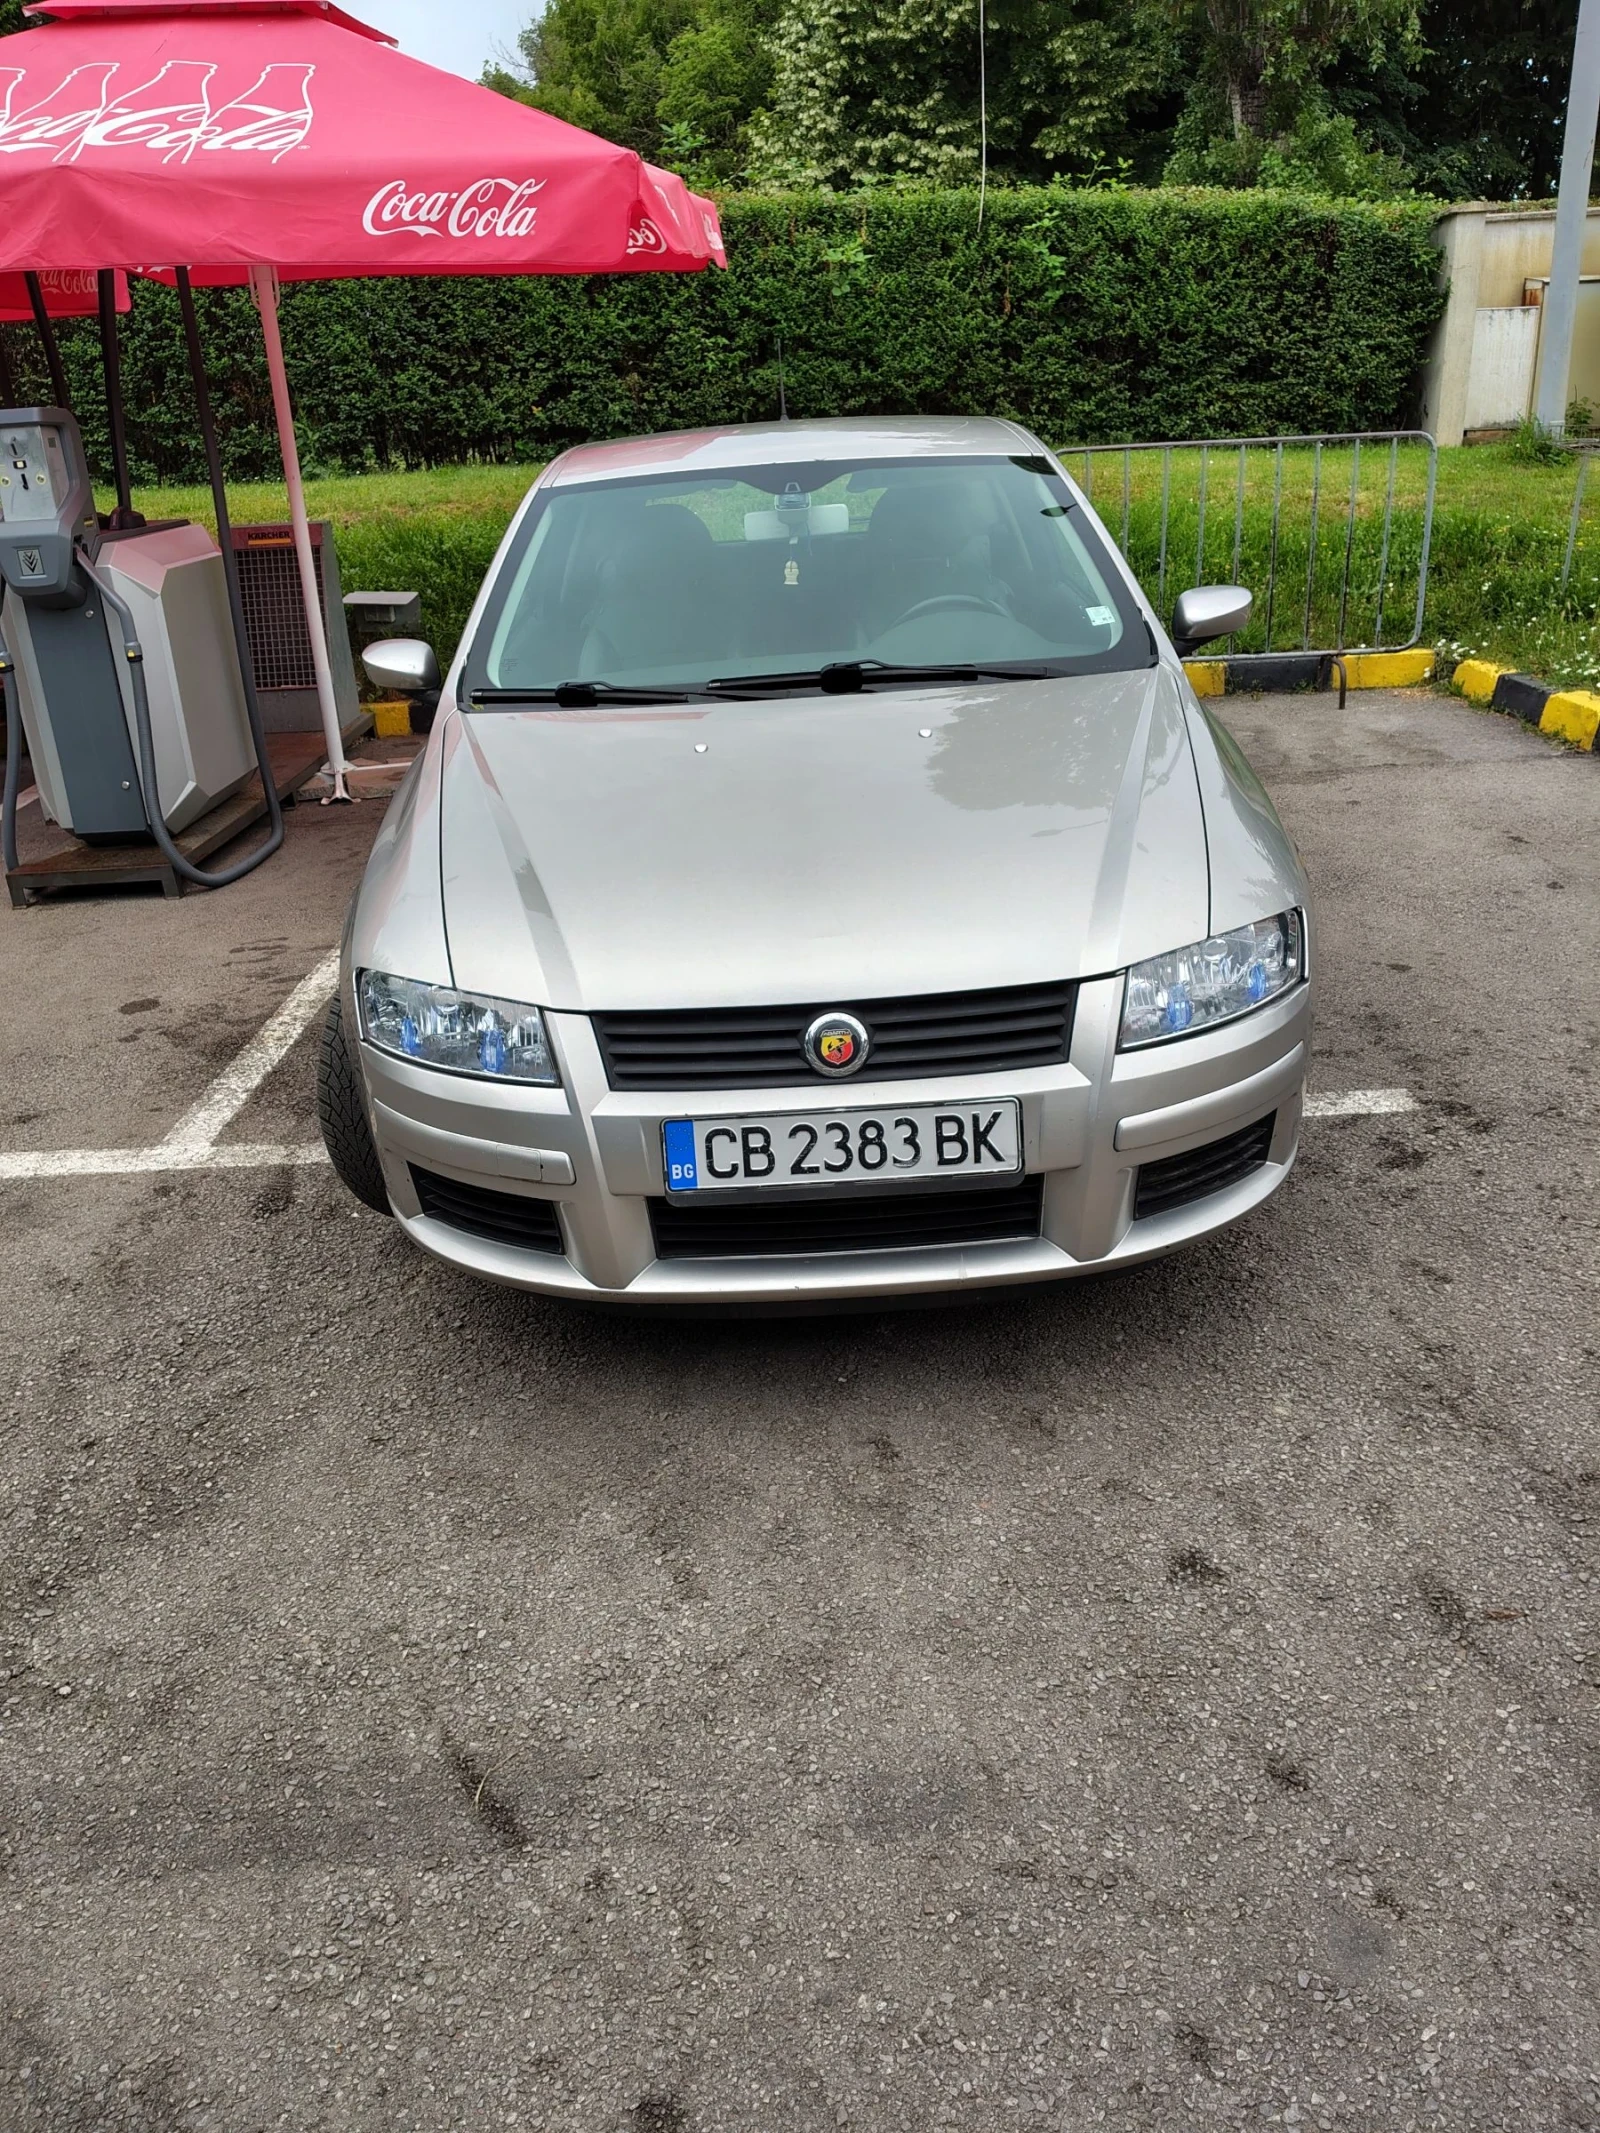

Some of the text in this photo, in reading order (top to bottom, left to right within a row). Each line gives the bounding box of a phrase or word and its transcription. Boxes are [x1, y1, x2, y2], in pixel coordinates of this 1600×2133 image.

[362, 178, 548, 238] Coca-Cola
[671, 1163, 694, 1179] BG
[704, 1110, 1006, 1179] CB 2383 BK
